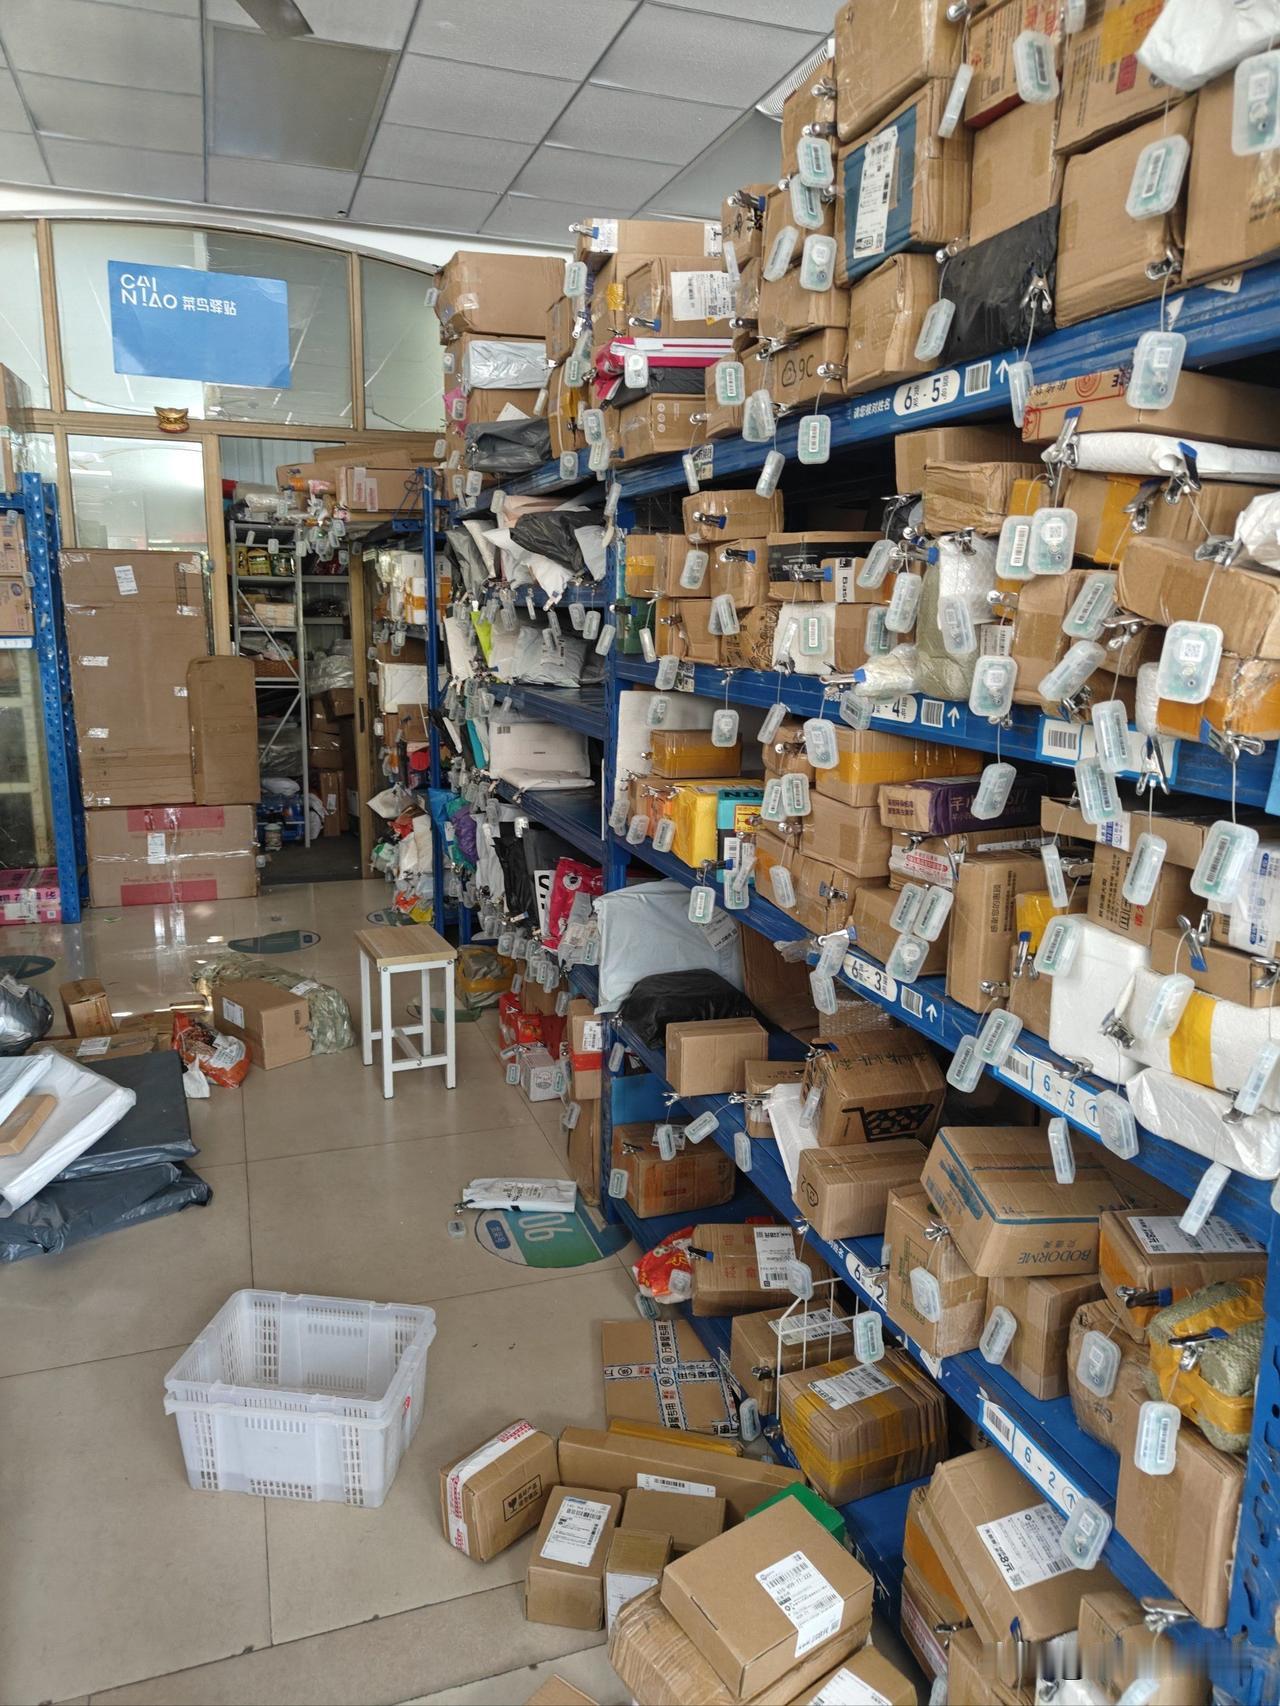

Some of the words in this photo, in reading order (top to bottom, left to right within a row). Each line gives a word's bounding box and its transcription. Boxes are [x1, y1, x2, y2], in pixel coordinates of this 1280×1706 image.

[120, 273, 157, 292] CAI
[182, 295, 237, 316] 菜鸟驿站
[1017, 1247, 1092, 1265] BODORME
